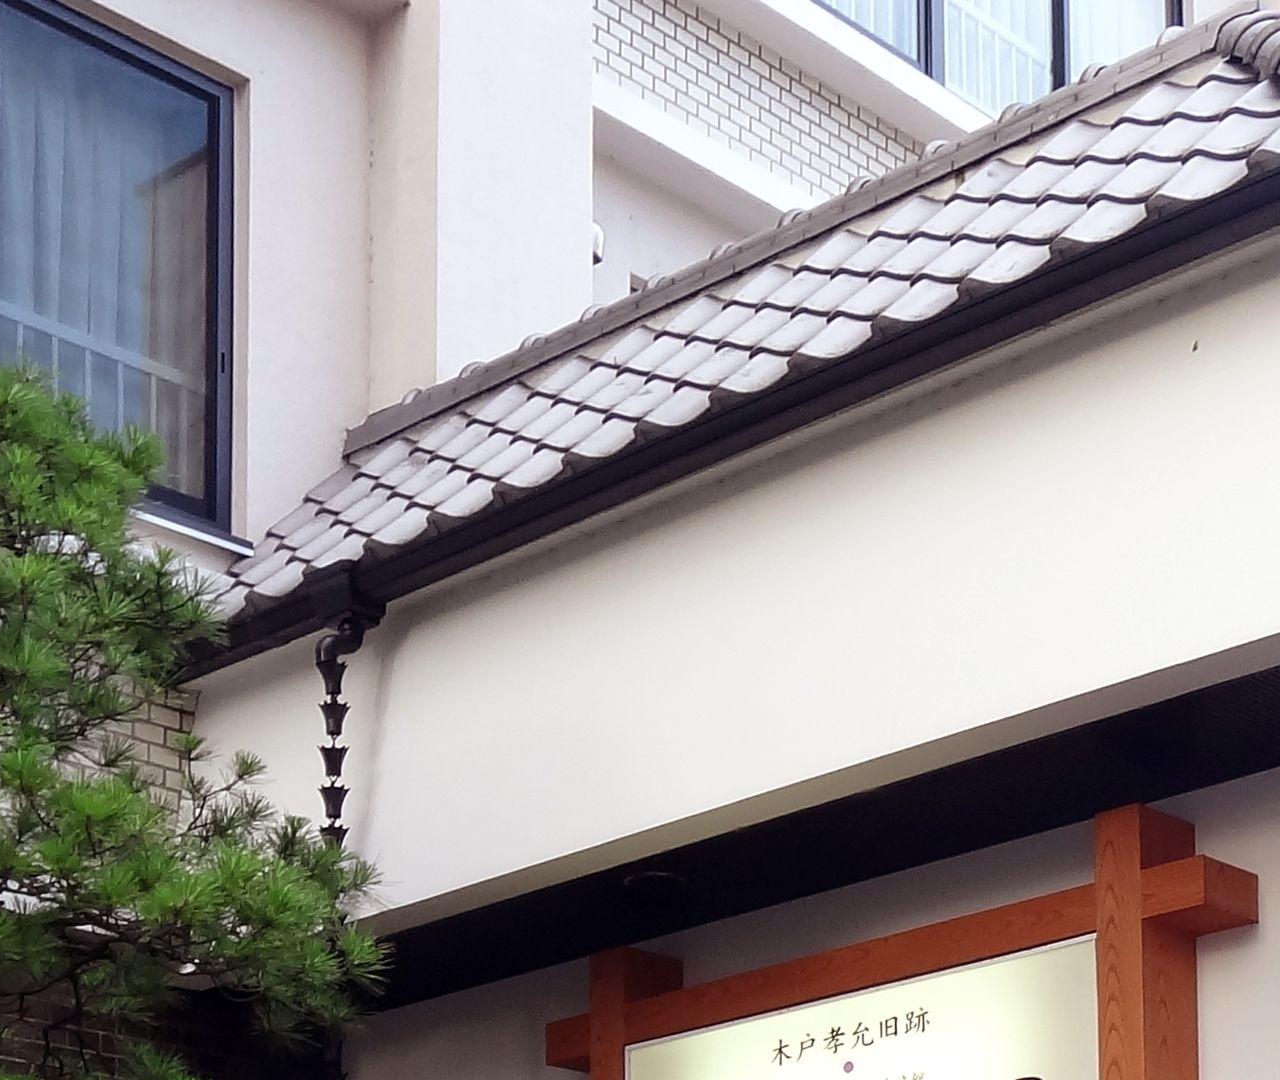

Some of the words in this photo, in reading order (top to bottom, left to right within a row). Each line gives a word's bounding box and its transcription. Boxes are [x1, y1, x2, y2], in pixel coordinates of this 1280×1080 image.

[771, 1006, 931, 1067] 木戸孝允旧跡
